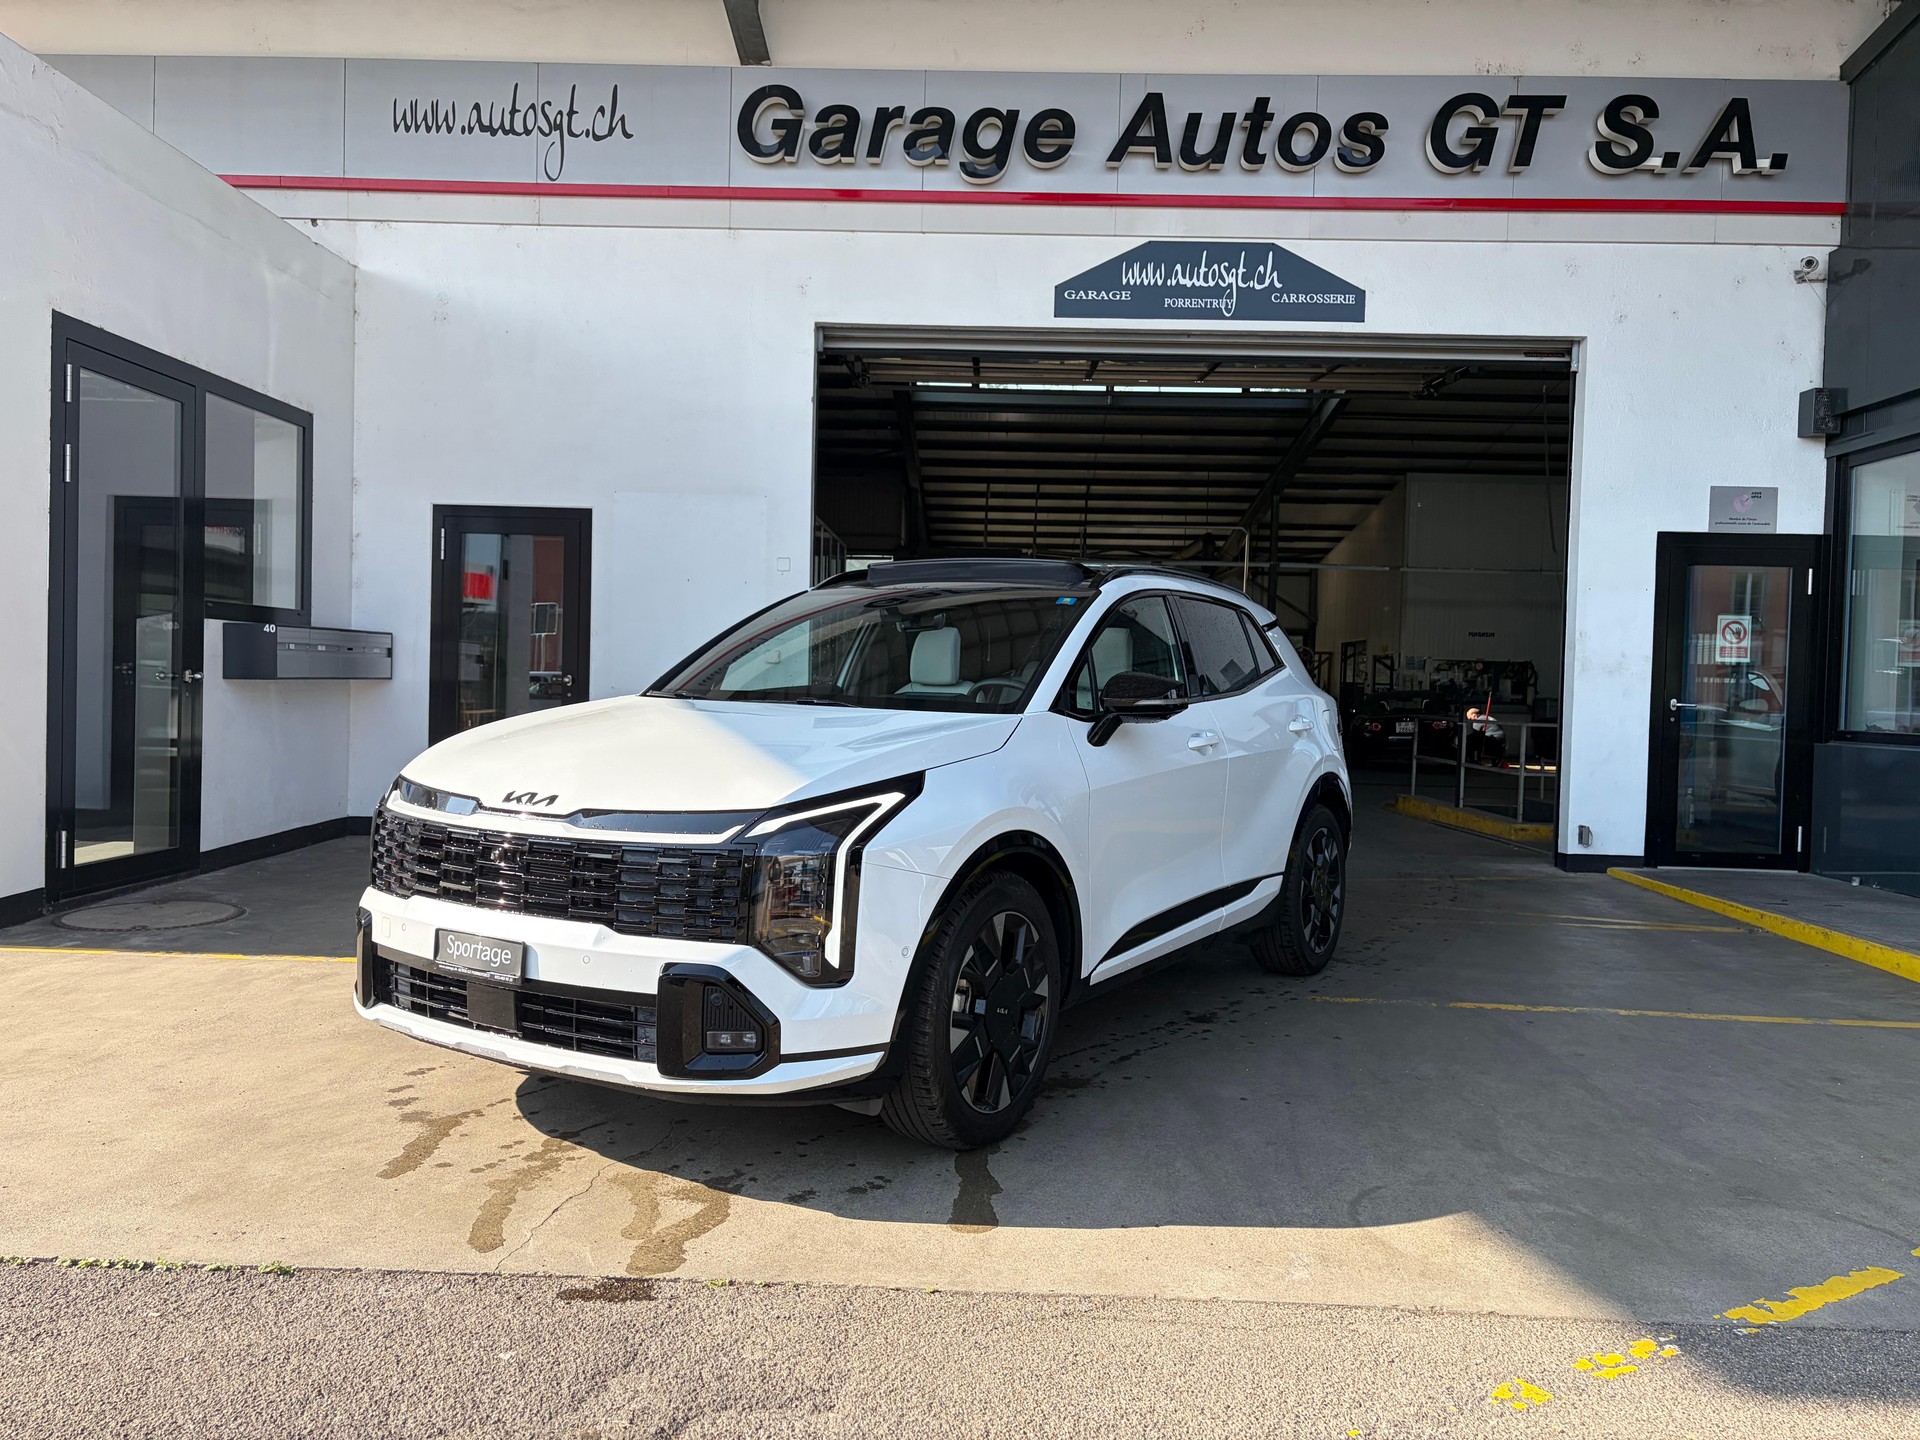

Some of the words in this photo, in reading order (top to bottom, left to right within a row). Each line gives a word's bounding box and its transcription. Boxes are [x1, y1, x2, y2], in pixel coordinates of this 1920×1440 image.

[393, 82, 634, 182] www.autosgt.ch
[737, 84, 1077, 185] Garage
[1105, 92, 1389, 174] Autos
[1425, 92, 1567, 174] GT
[1589, 94, 1789, 175] S.A.
[1121, 250, 1283, 317] www.autosgt.ch
[1064, 289, 1131, 301] GARAGE
[1164, 297, 1234, 309] PORRENTRUY
[1271, 292, 1356, 304] CARROSSERIE
[263, 624, 276, 633] 40
[446, 935, 512, 968] Sportage
